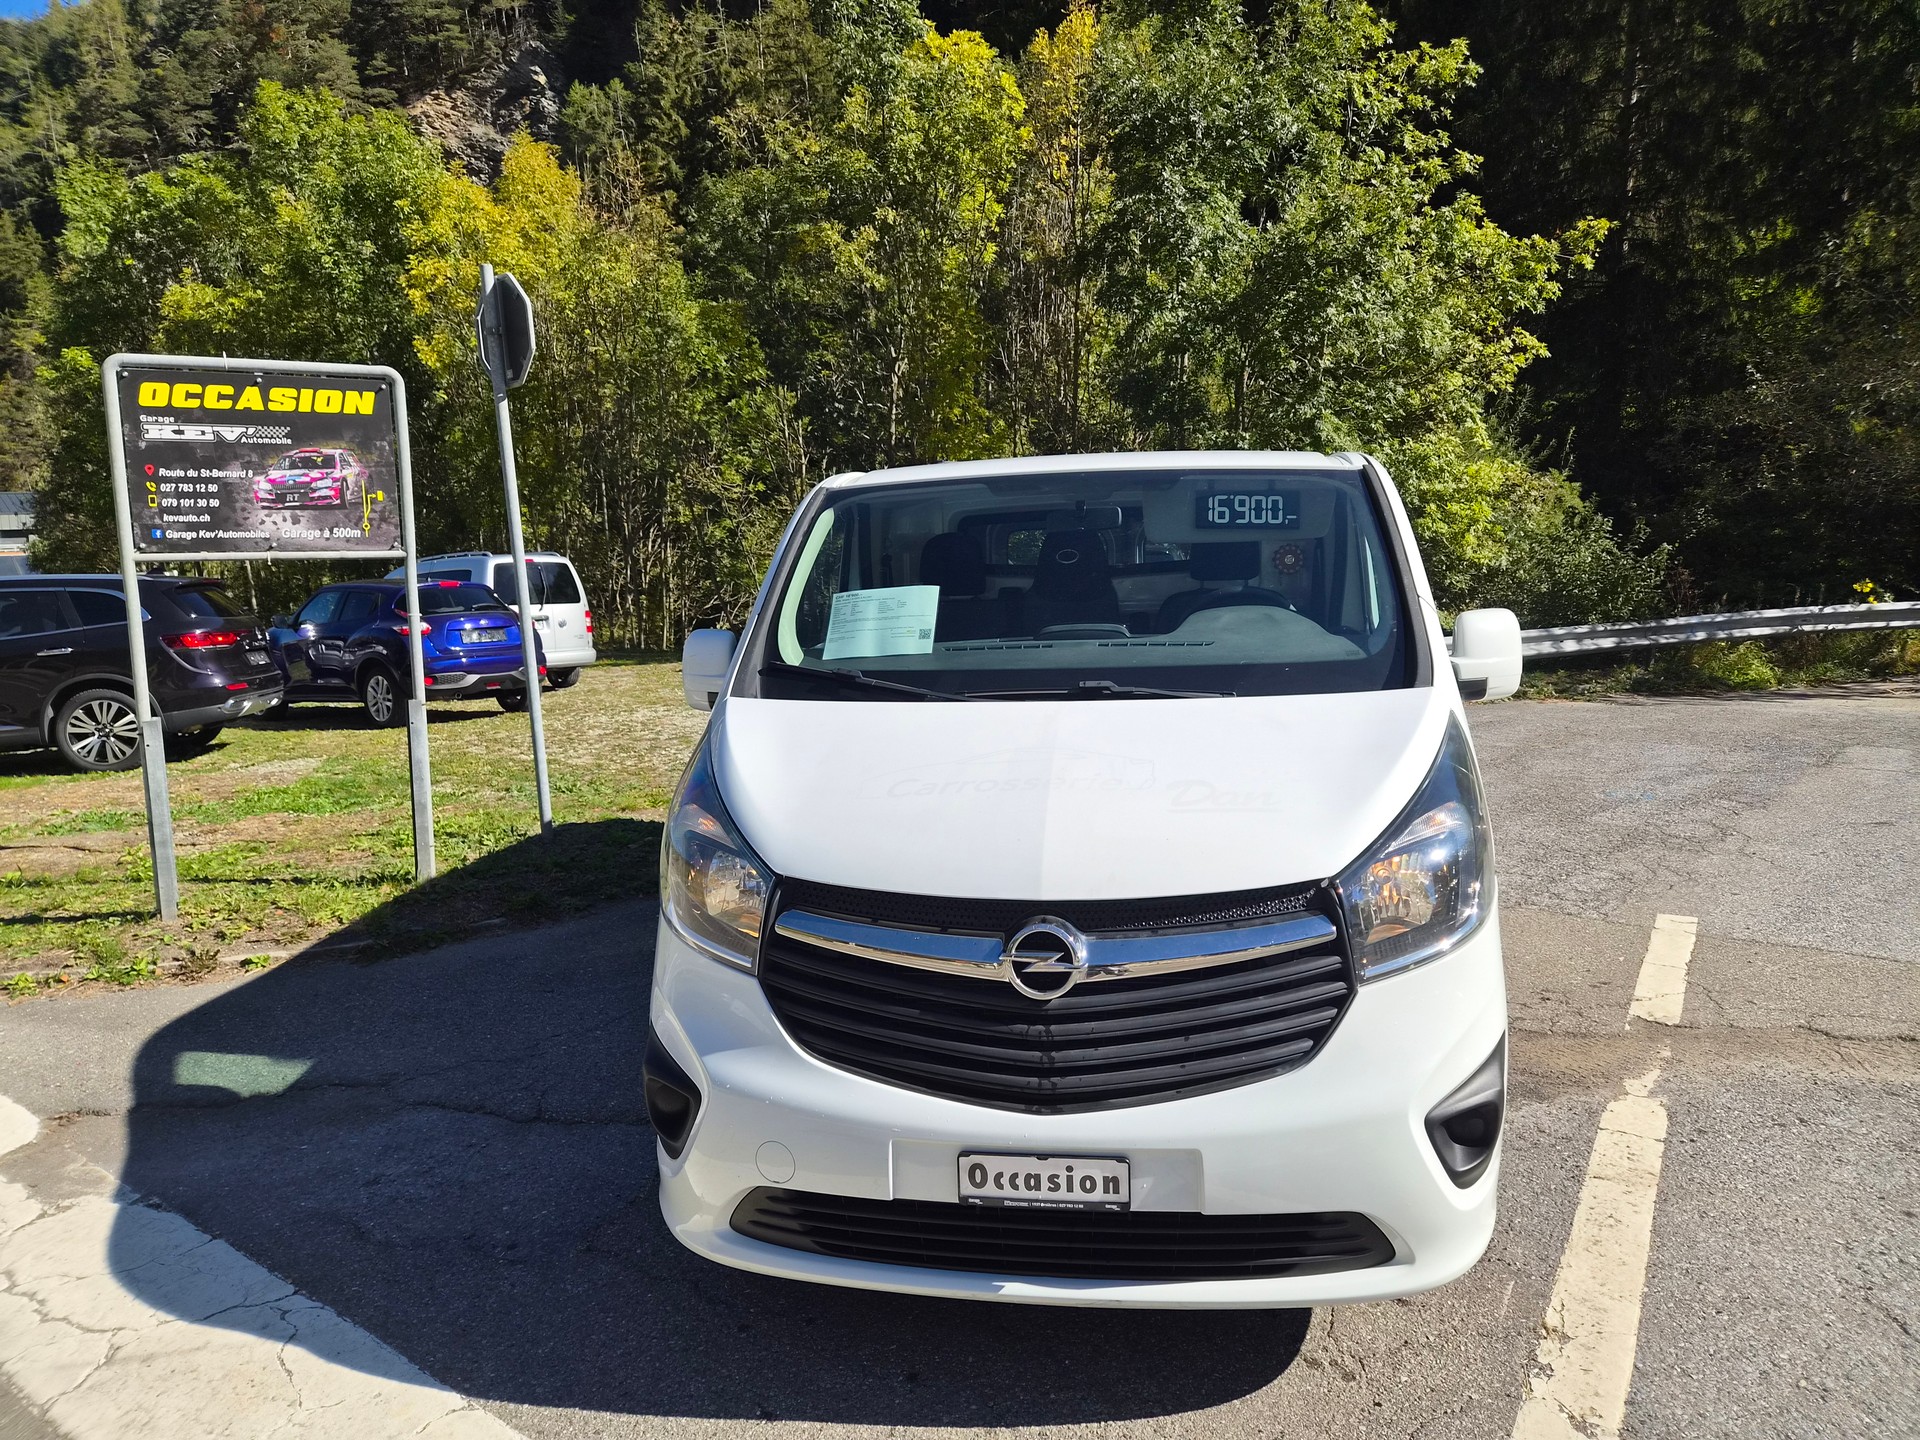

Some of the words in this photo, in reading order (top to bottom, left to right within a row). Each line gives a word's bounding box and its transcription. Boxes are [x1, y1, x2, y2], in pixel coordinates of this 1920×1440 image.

[138, 382, 375, 415] OCCASION
[140, 415, 175, 423] Garage
[241, 436, 292, 445] Automobile
[159, 468, 185, 477] Route
[187, 468, 198, 478] du
[200, 469, 246, 478] St-Bernard
[247, 470, 254, 479] 8
[160, 483, 177, 492] 027
[178, 484, 194, 492] 783
[195, 484, 207, 493] 12
[207, 484, 218, 493] 50
[161, 499, 178, 507] 079
[179, 499, 195, 507] 101
[197, 499, 208, 508] 30
[209, 499, 220, 508] 50
[163, 513, 211, 523] kevauto.ch
[165, 530, 197, 540] Garage
[281, 529, 321, 540] Garage
[323, 528, 331, 538] à
[332, 528, 361, 538] 500m
[887, 772, 1126, 798] Carrosserie
[967, 1162, 1121, 1195] Occasion
